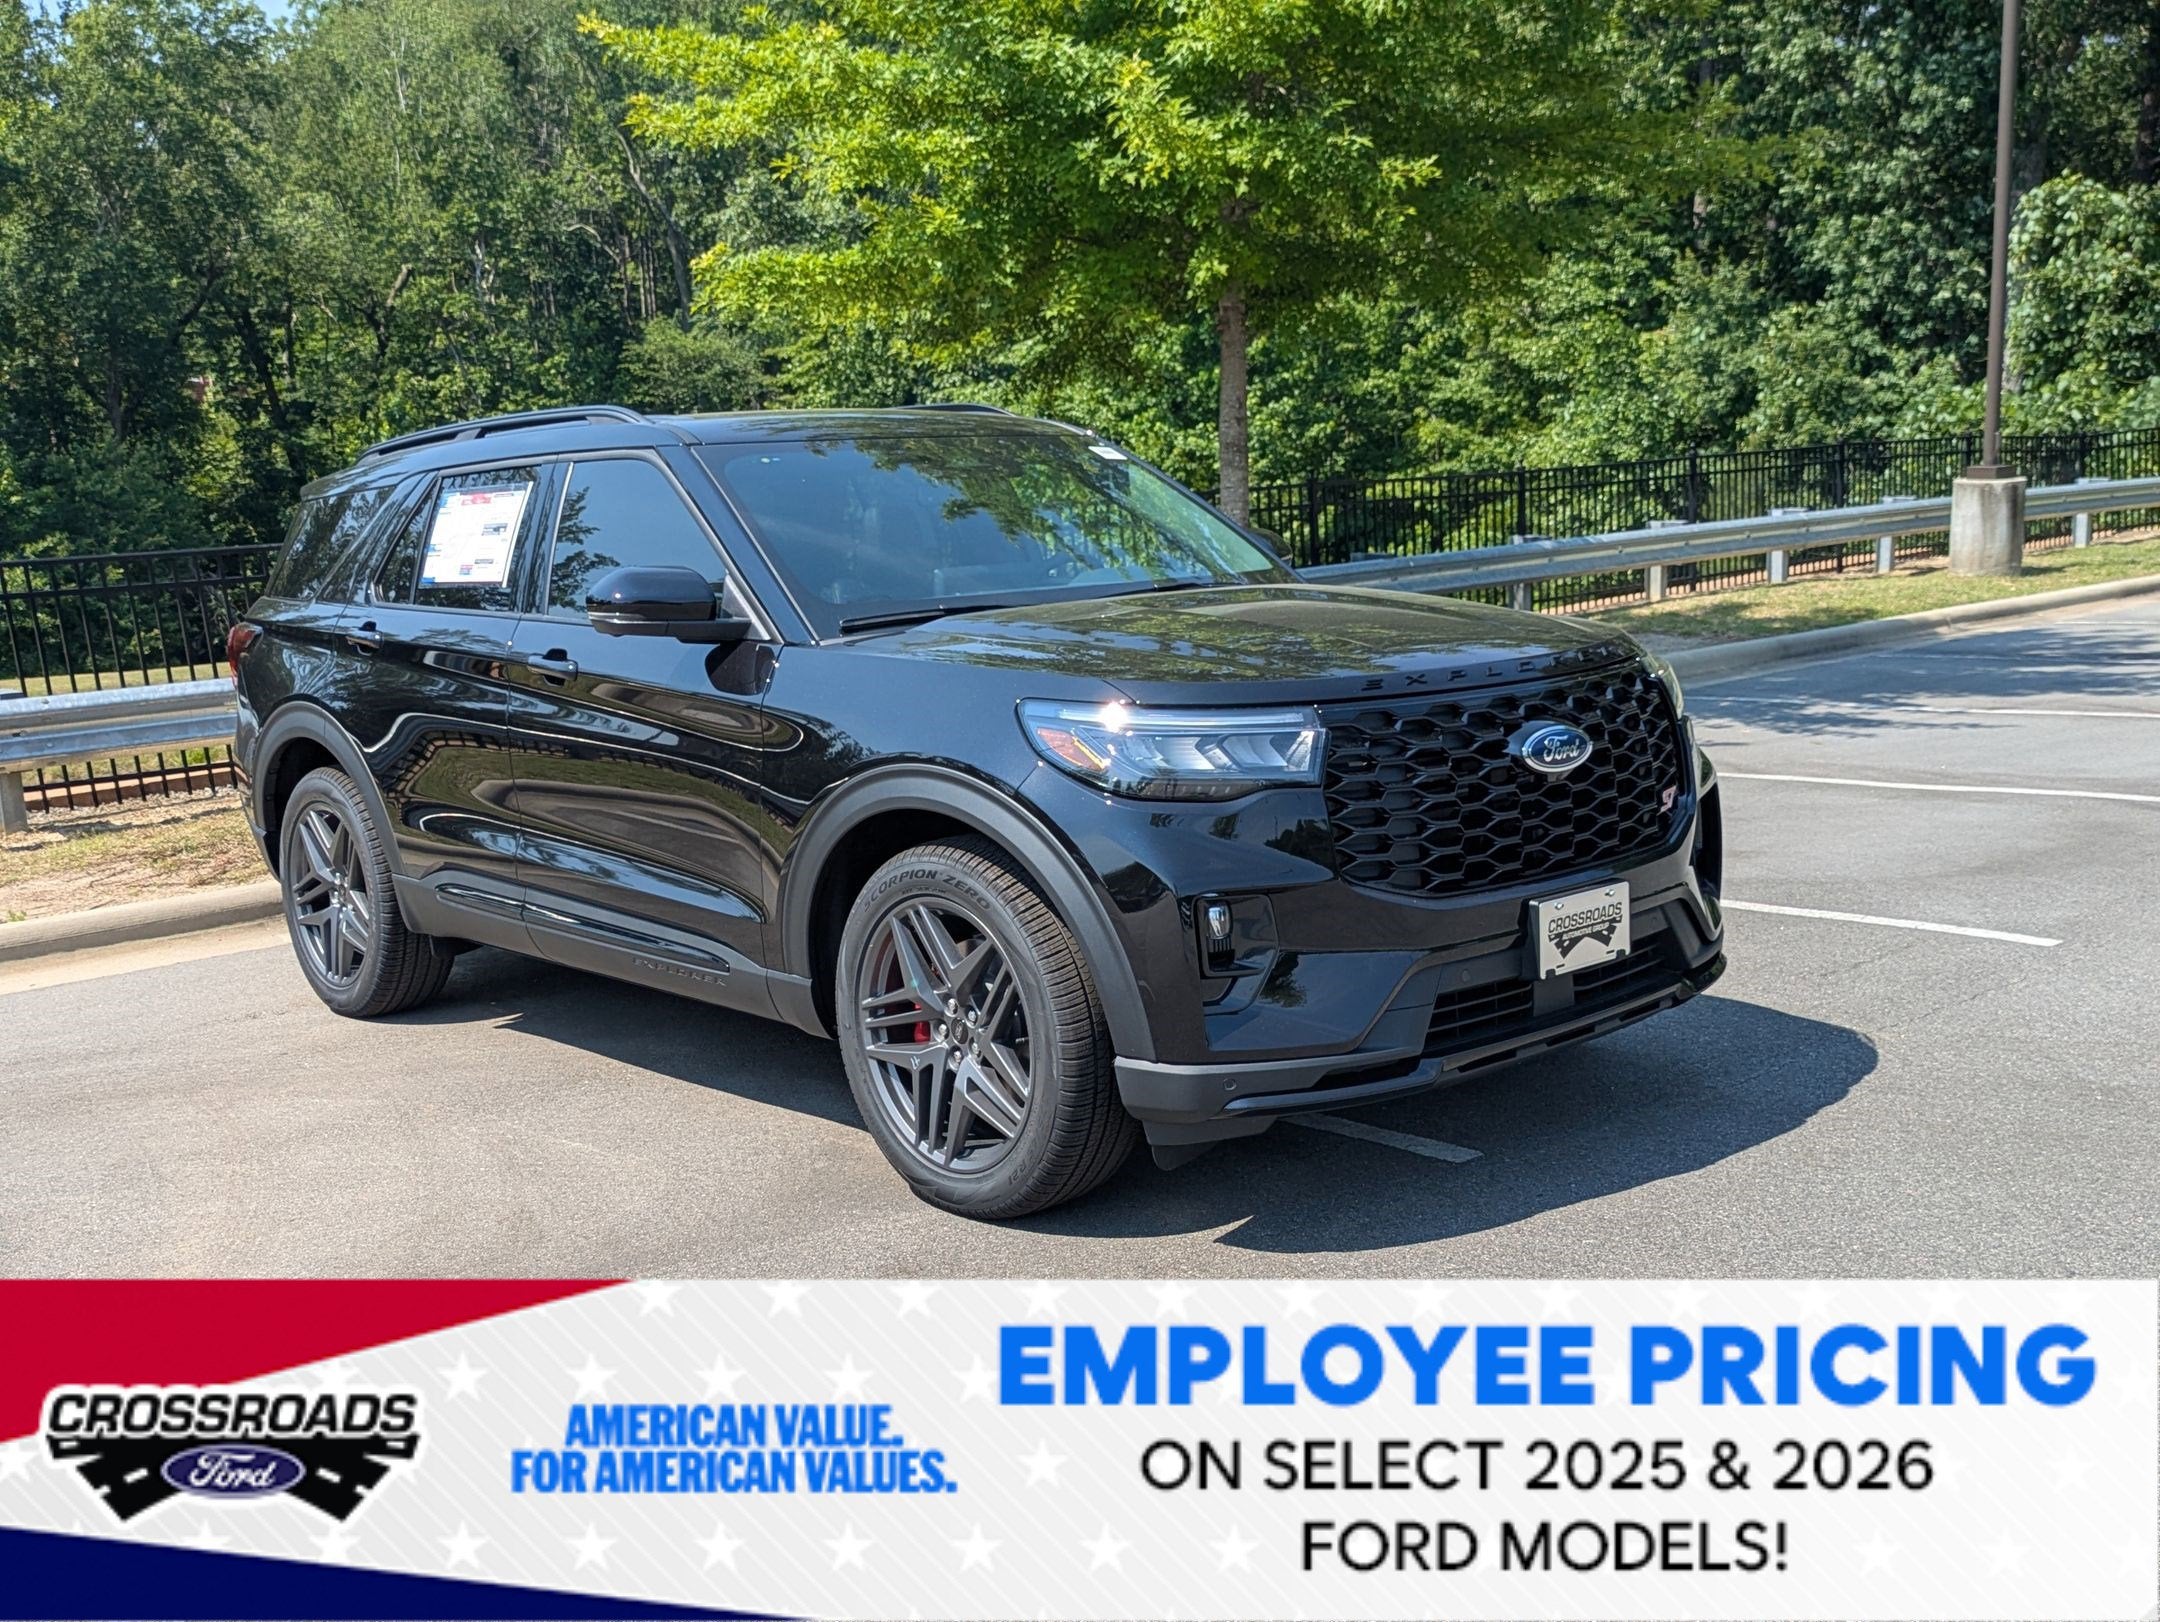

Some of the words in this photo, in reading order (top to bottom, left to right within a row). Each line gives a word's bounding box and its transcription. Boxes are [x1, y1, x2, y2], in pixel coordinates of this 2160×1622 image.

[1543, 735, 1580, 762] Ford
[864, 869, 938, 912] SCORPION
[943, 875, 991, 910] ZERO
[1548, 902, 1623, 933] CROSSROADS
